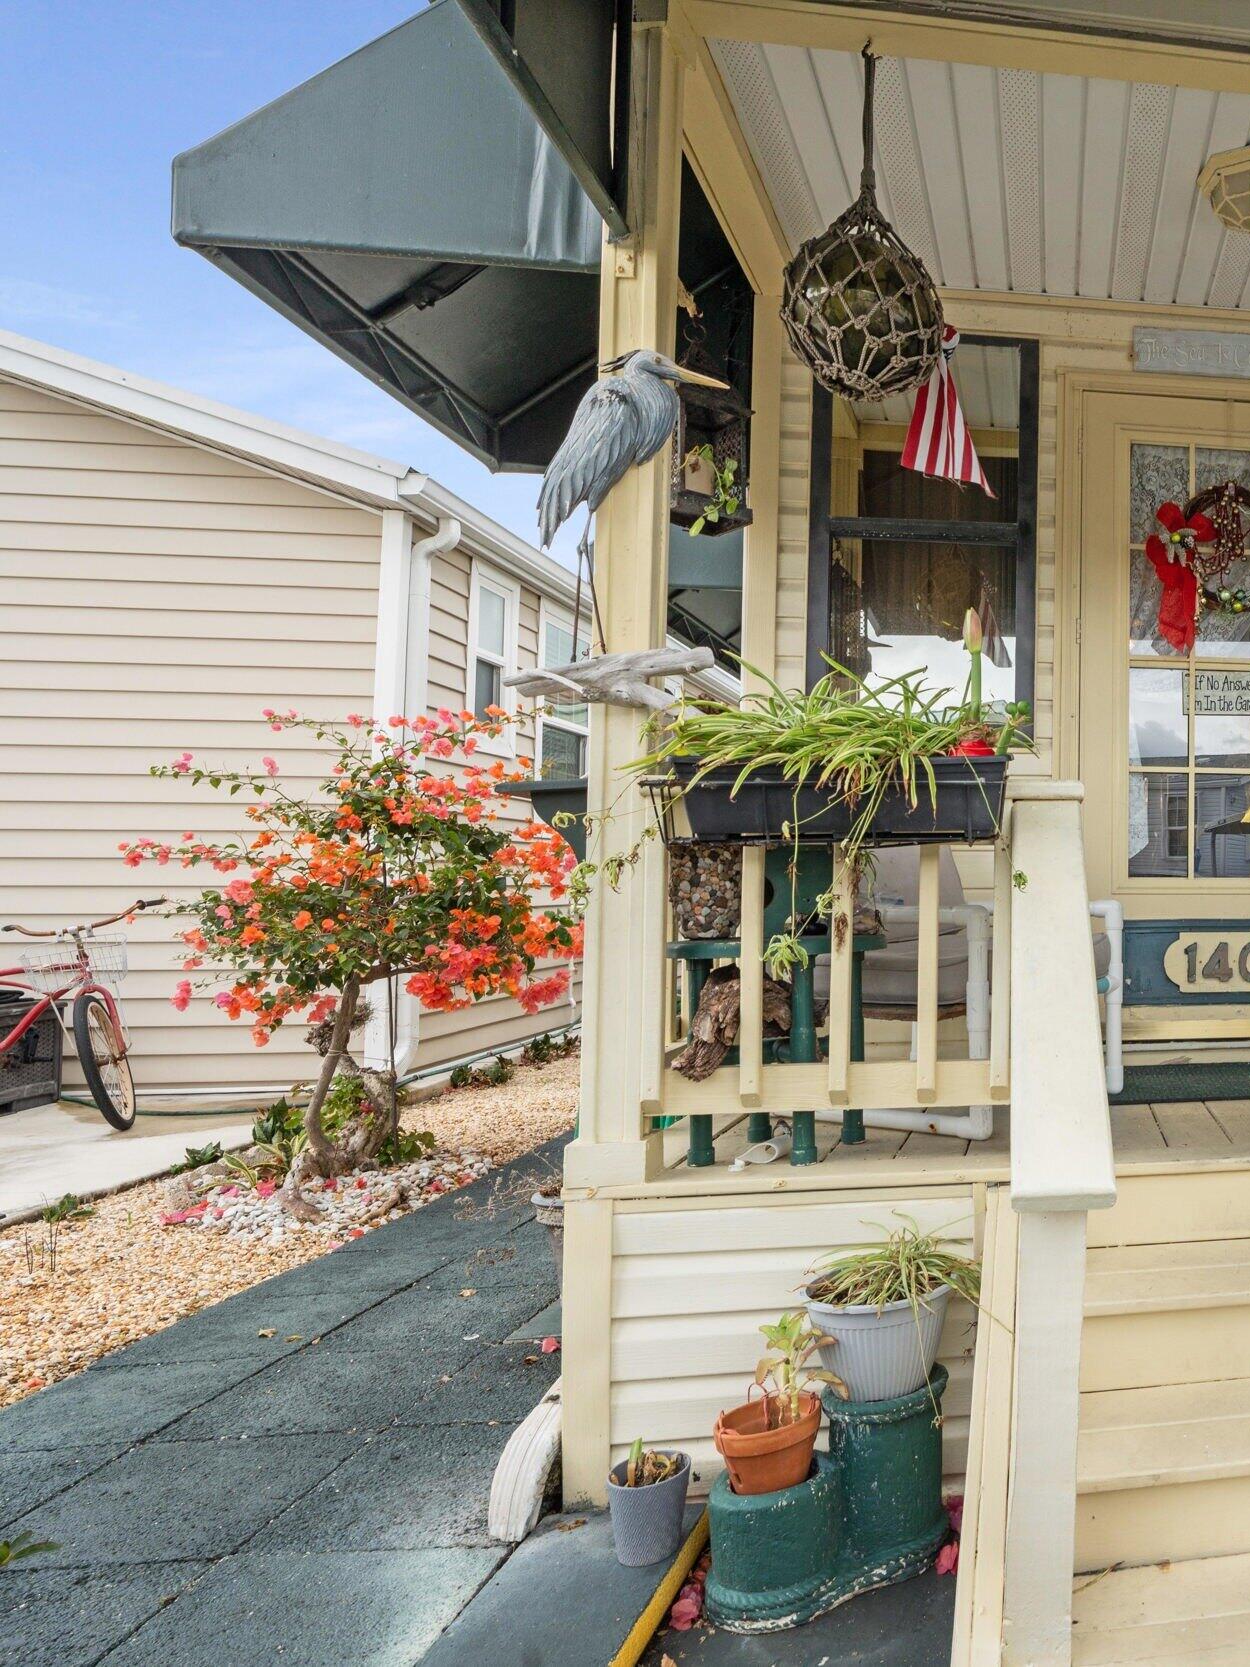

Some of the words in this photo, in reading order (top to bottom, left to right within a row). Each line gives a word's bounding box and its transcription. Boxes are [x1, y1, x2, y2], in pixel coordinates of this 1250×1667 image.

[1142, 338, 1168, 366] The
[1175, 341, 1205, 367] Sea
[1194, 675, 1205, 690] If
[1207, 675, 1219, 690] No
[1204, 695, 1217, 711] In
[1217, 695, 1233, 711] the
